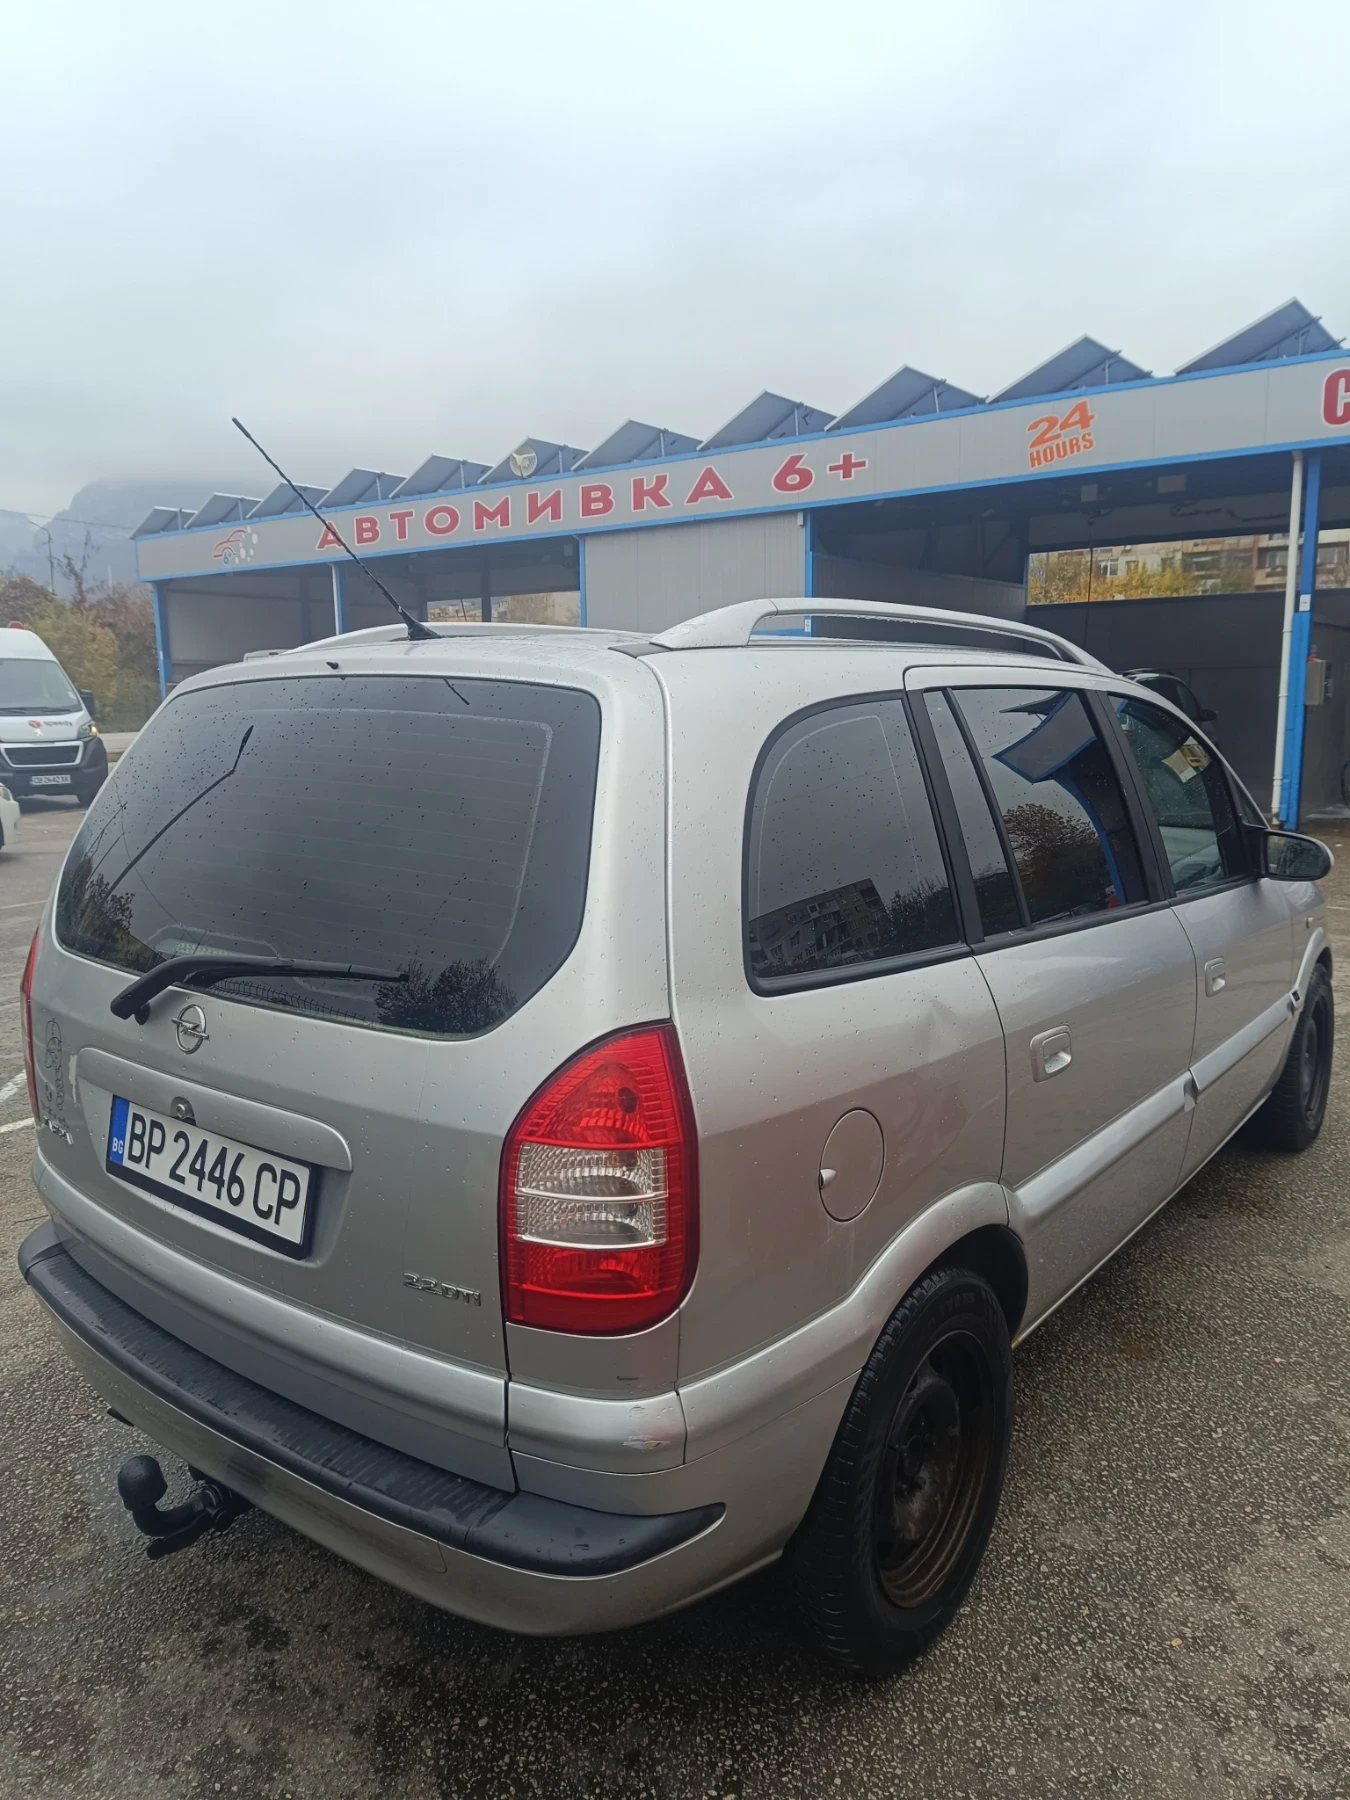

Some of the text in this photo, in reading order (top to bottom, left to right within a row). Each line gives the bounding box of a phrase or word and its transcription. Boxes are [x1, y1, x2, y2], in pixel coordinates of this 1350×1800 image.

[1027, 400, 1096, 449] 24
[1029, 431, 1095, 469] HOURS
[317, 453, 868, 550] АВТОМИВКА 6+
[112, 1137, 124, 1154] BG
[127, 1112, 166, 1170] BP
[168, 1130, 246, 1207] 2446
[252, 1162, 301, 1226] CP
